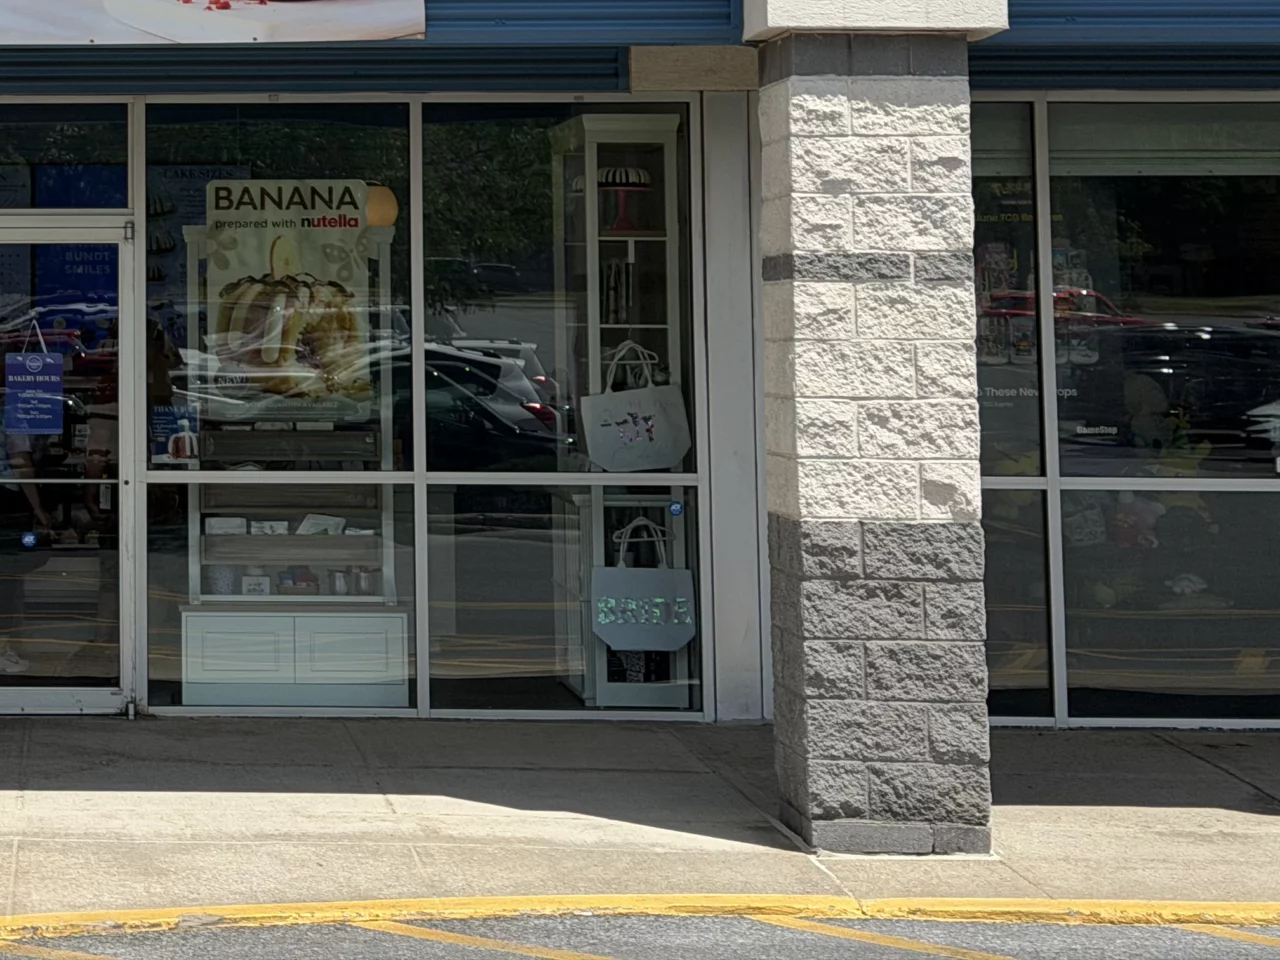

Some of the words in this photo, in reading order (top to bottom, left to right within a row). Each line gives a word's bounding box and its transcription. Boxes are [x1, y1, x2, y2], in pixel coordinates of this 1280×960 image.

[164, 169, 197, 180] CAKE
[215, 186, 360, 210] BANANA
[215, 219, 268, 230] prepared
[272, 219, 297, 228] with
[301, 214, 359, 228] nutella
[217, 376, 248, 385] NEW!
[984, 386, 1017, 397] These
[1076, 425, 1118, 434] GameStop
